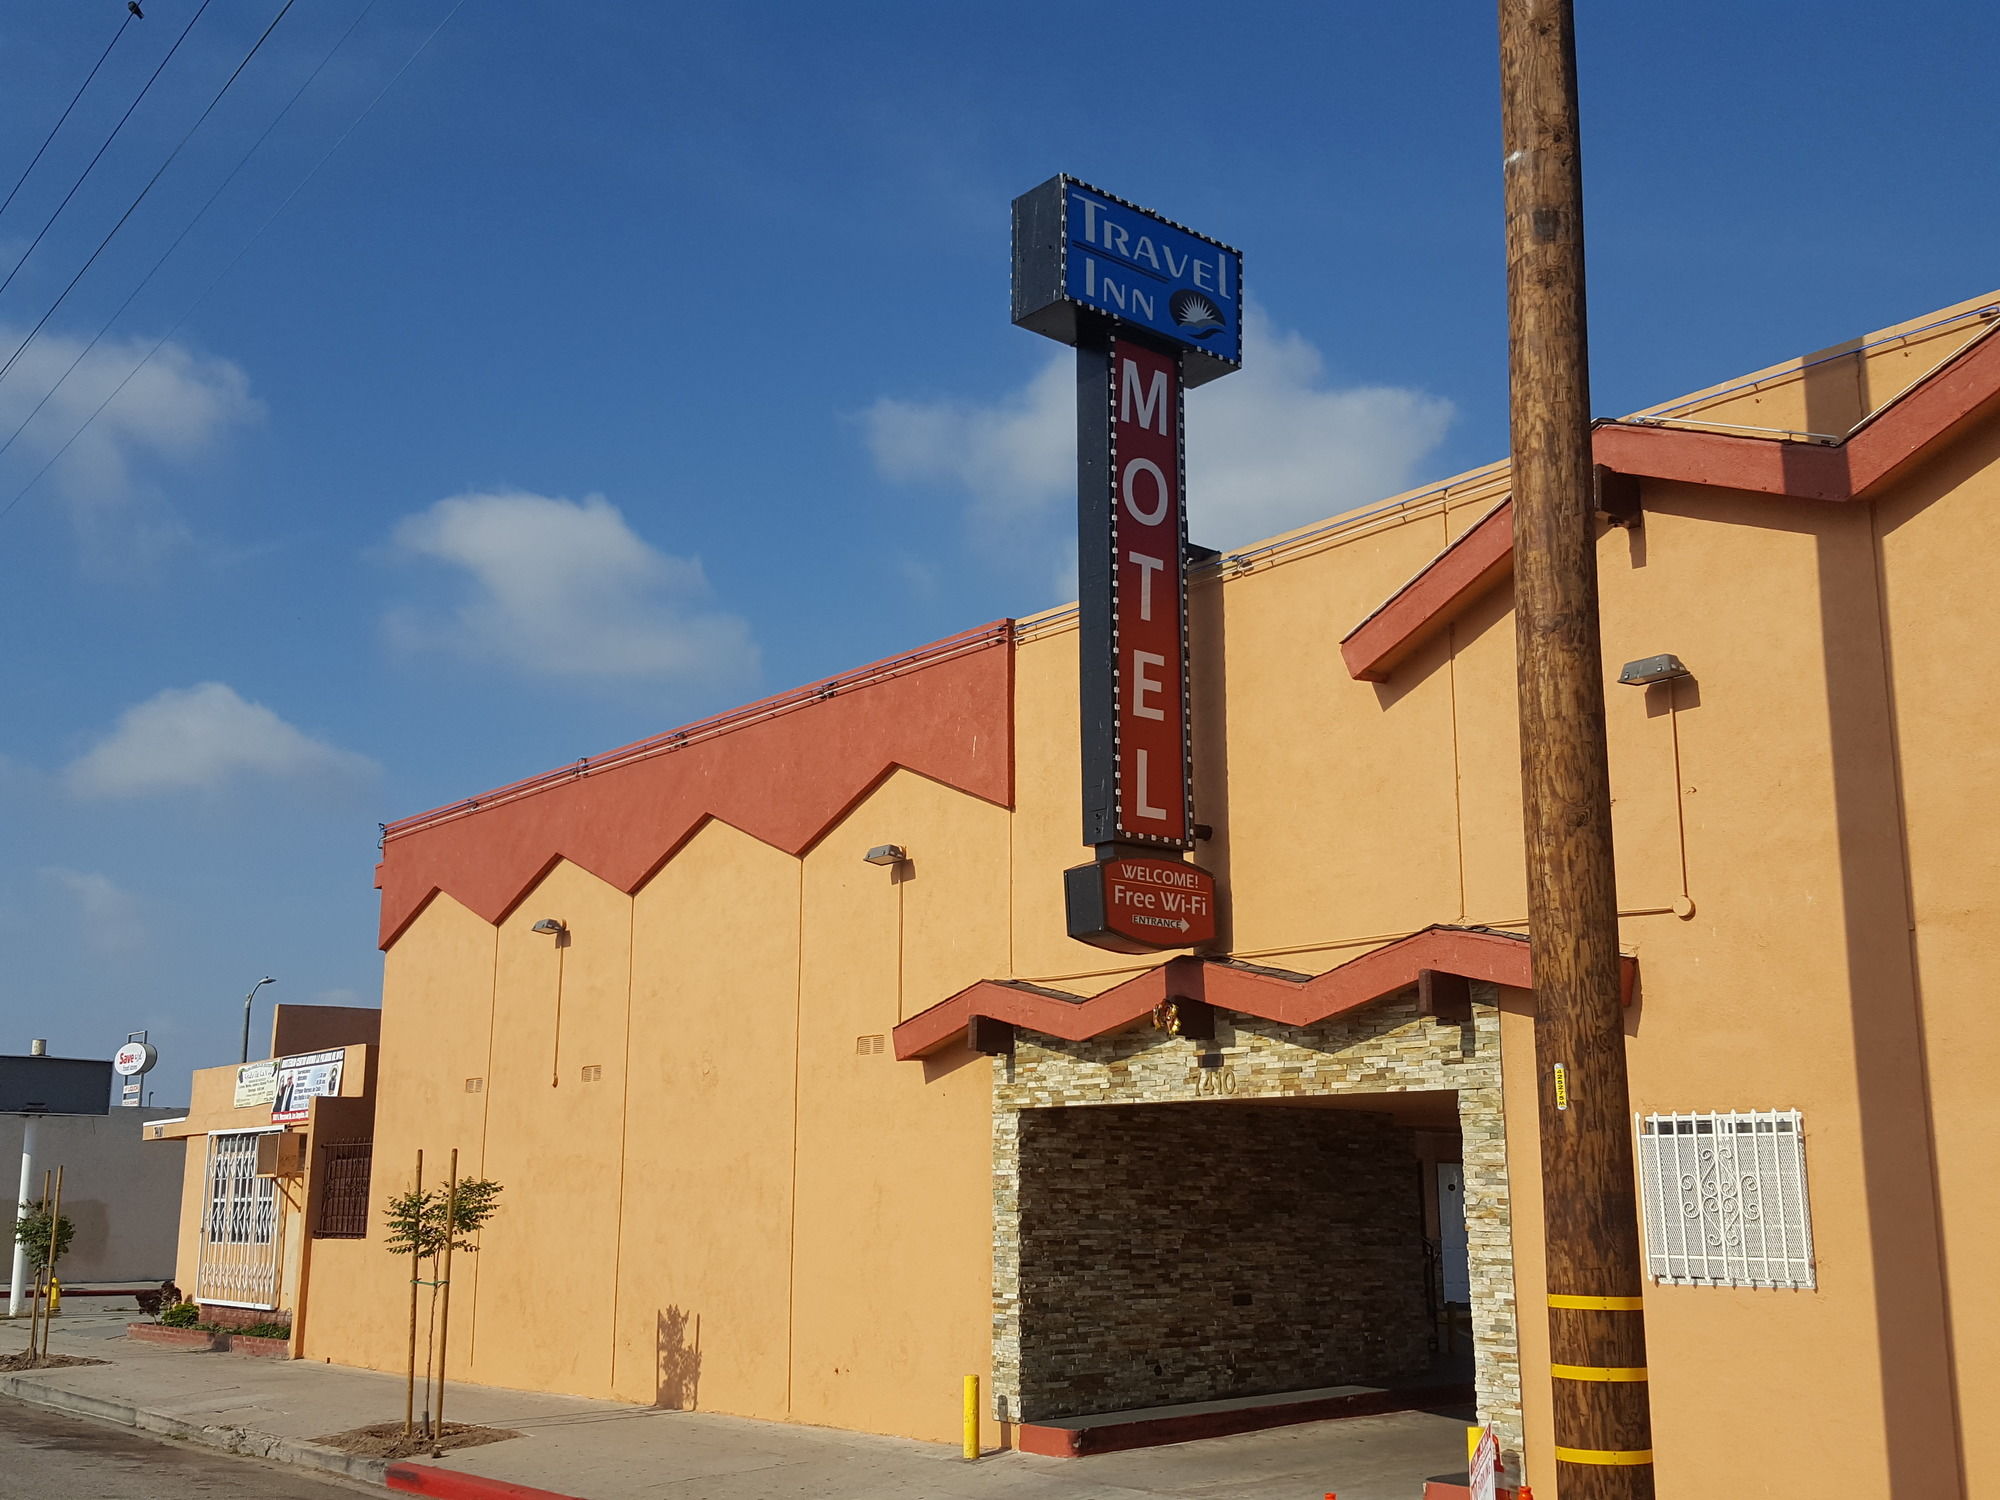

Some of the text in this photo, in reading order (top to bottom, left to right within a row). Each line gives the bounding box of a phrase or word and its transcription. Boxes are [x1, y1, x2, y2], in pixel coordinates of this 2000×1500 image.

[1072, 193, 1231, 299] TRAVEL
[1085, 257, 1154, 321] INN
[1120, 357, 1169, 821] MOTEL
[1121, 863, 1199, 889] WELCOME!
[1114, 885, 1206, 916] Free Wi-Fi
[1132, 915, 1182, 929] ENTRANCE
[119, 1052, 134, 1065] Save
